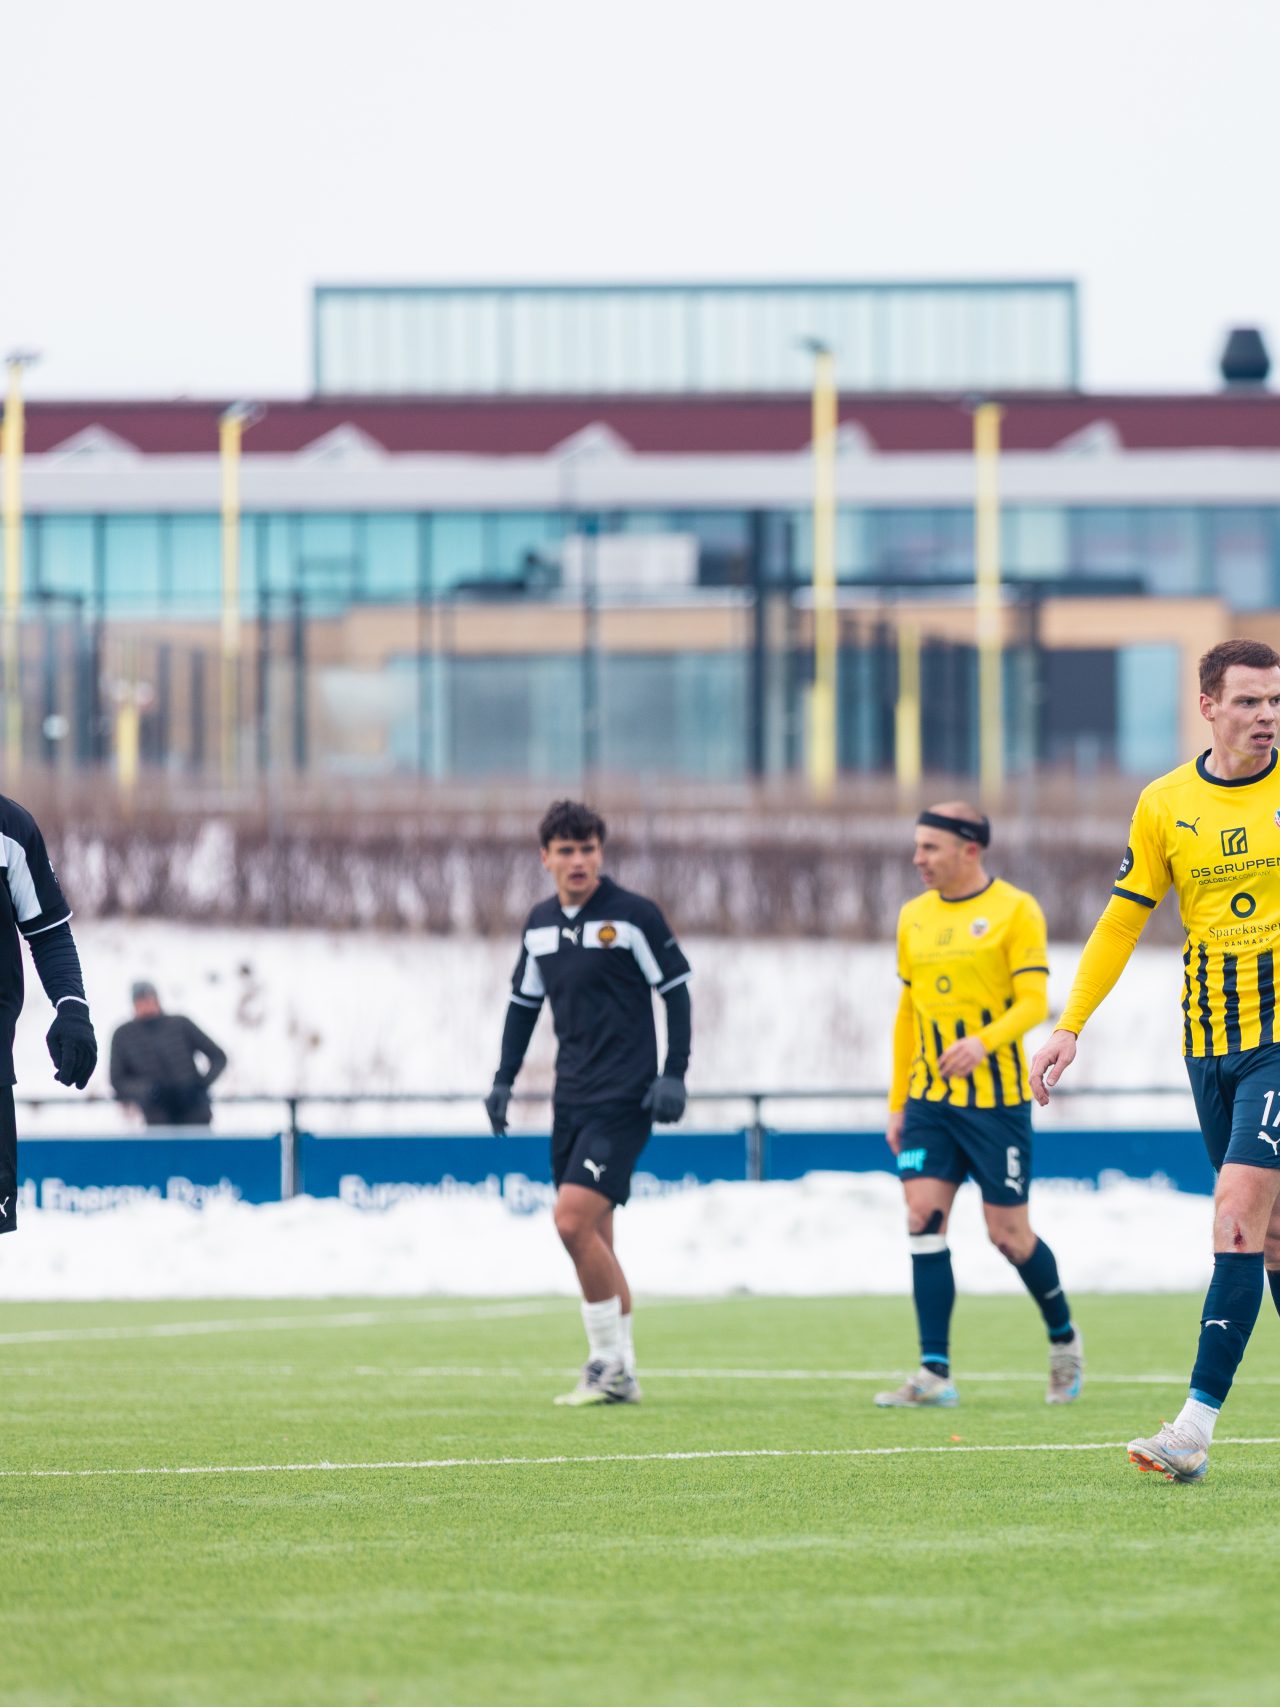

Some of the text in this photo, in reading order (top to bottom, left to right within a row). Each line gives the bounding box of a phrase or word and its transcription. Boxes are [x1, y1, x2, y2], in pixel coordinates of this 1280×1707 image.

[1191, 867, 1211, 879] DS
[1198, 870, 1271, 886] GOLDBECK COMPANY
[1225, 937, 1270, 947] DANMARK
[1006, 1146, 1020, 1178] 6
